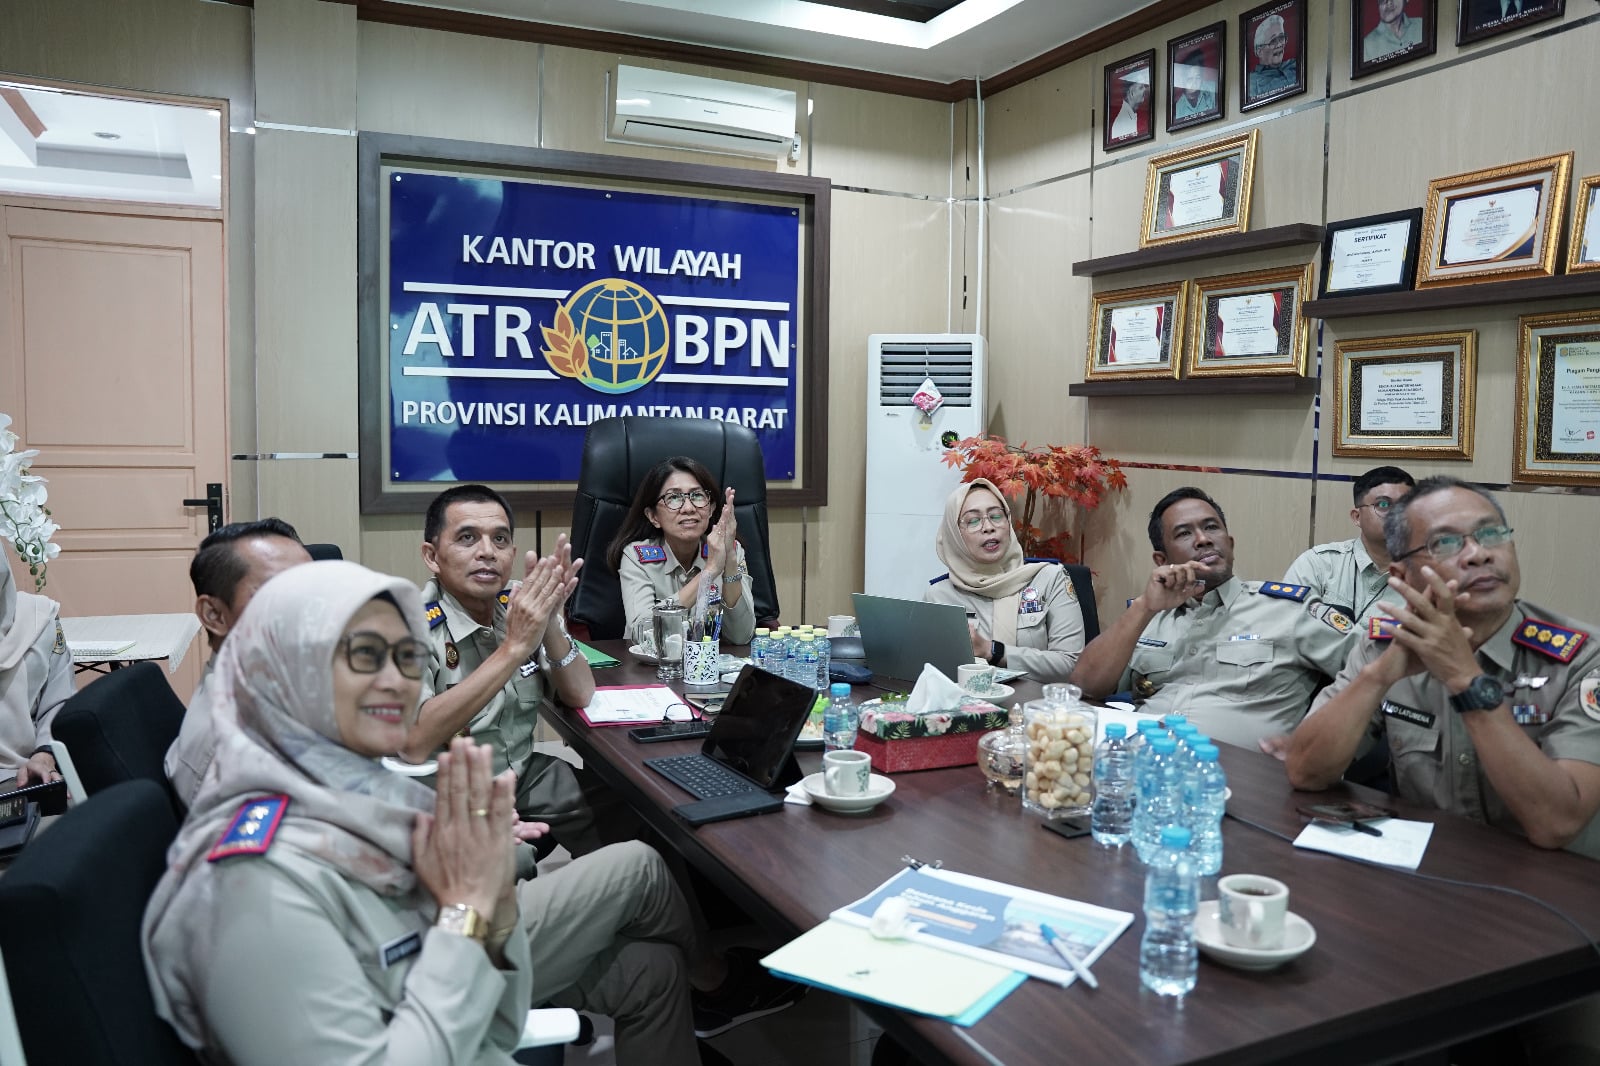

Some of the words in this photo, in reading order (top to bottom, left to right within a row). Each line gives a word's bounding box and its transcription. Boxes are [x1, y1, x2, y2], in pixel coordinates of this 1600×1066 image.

[462, 234, 595, 270] KANTOR
[614, 244, 742, 280] WILAYAH
[403, 302, 533, 360] ATR
[674, 314, 790, 369] BPN
[402, 400, 526, 427] PROVINSI
[710, 407, 788, 430] BARAT
